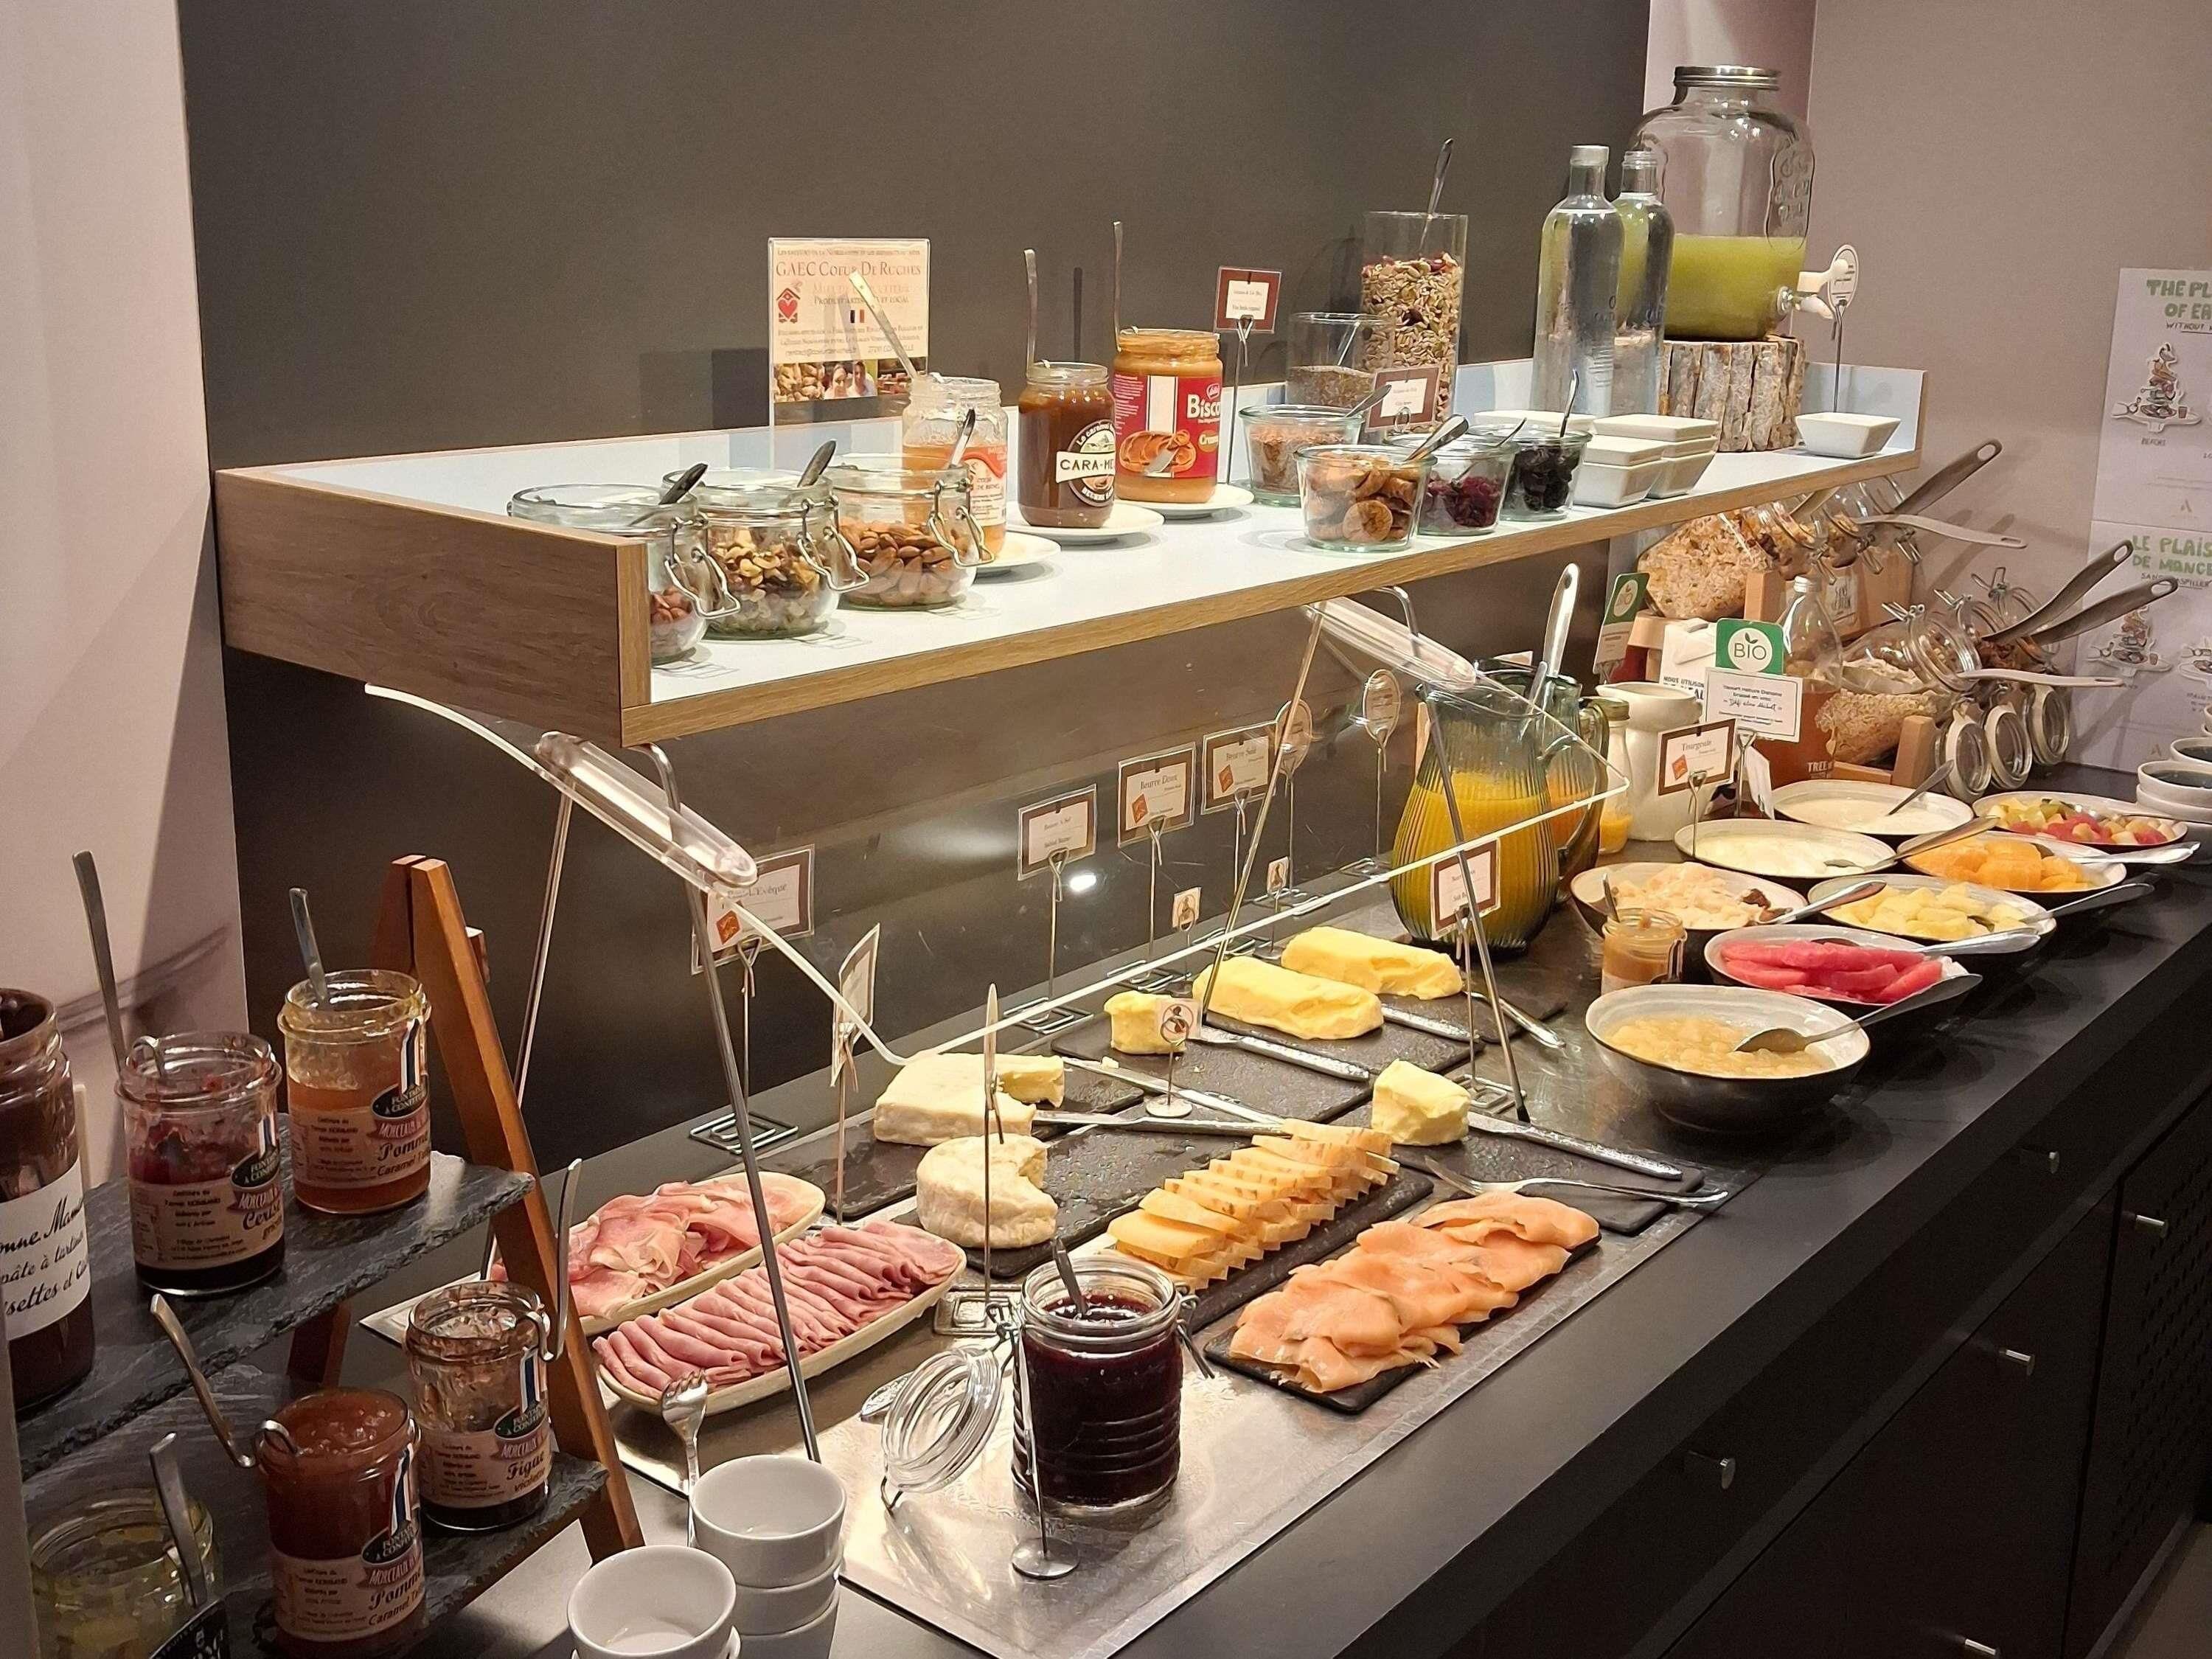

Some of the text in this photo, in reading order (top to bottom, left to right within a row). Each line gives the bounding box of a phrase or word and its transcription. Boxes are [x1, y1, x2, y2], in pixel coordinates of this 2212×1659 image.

[776, 262, 815, 276] GAEC
[2146, 279, 2212, 298] THE PL
[2164, 303, 2188, 318] OF
[2132, 535, 2151, 552] LE
[2132, 554, 2151, 568] DE
[1733, 642, 1767, 661] BIO
